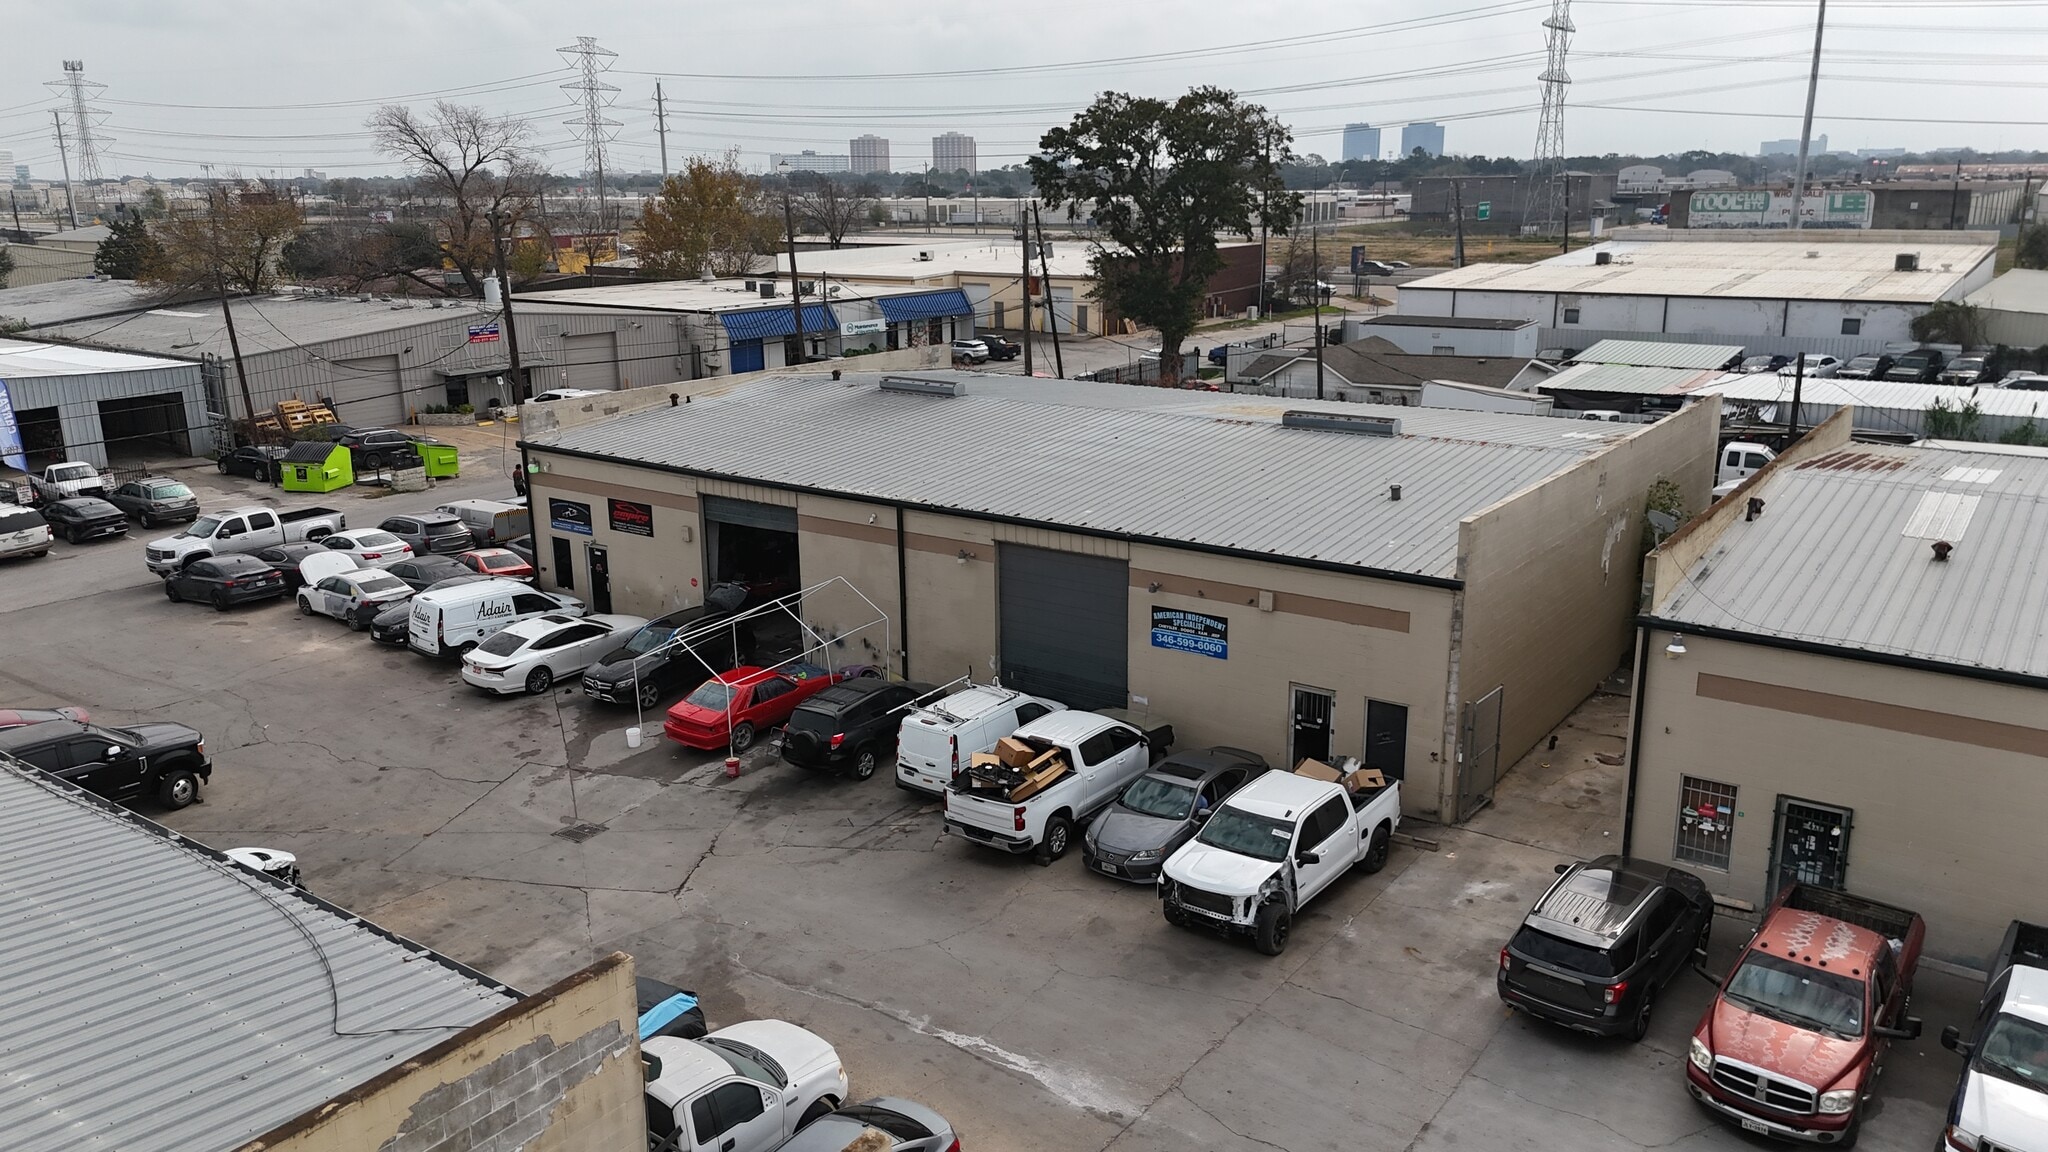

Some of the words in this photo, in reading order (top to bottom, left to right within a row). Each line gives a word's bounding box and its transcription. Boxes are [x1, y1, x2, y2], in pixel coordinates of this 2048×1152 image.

[1693, 193, 1743, 211] TOOL
[1737, 192, 1765, 202] CLUB
[1774, 190, 1824, 198] WHOSALE
[1829, 193, 1866, 212] LEE
[1743, 201, 1764, 210] ETC
[412, 604, 430, 623] Adair
[477, 600, 512, 620] Adair
[1153, 611, 1184, 620] AMERICAN
[1185, 613, 1226, 631] INDEPENDENT
[1173, 619, 1205, 631] SPECIALIST
[1156, 634, 1222, 653] 346-599-6060
